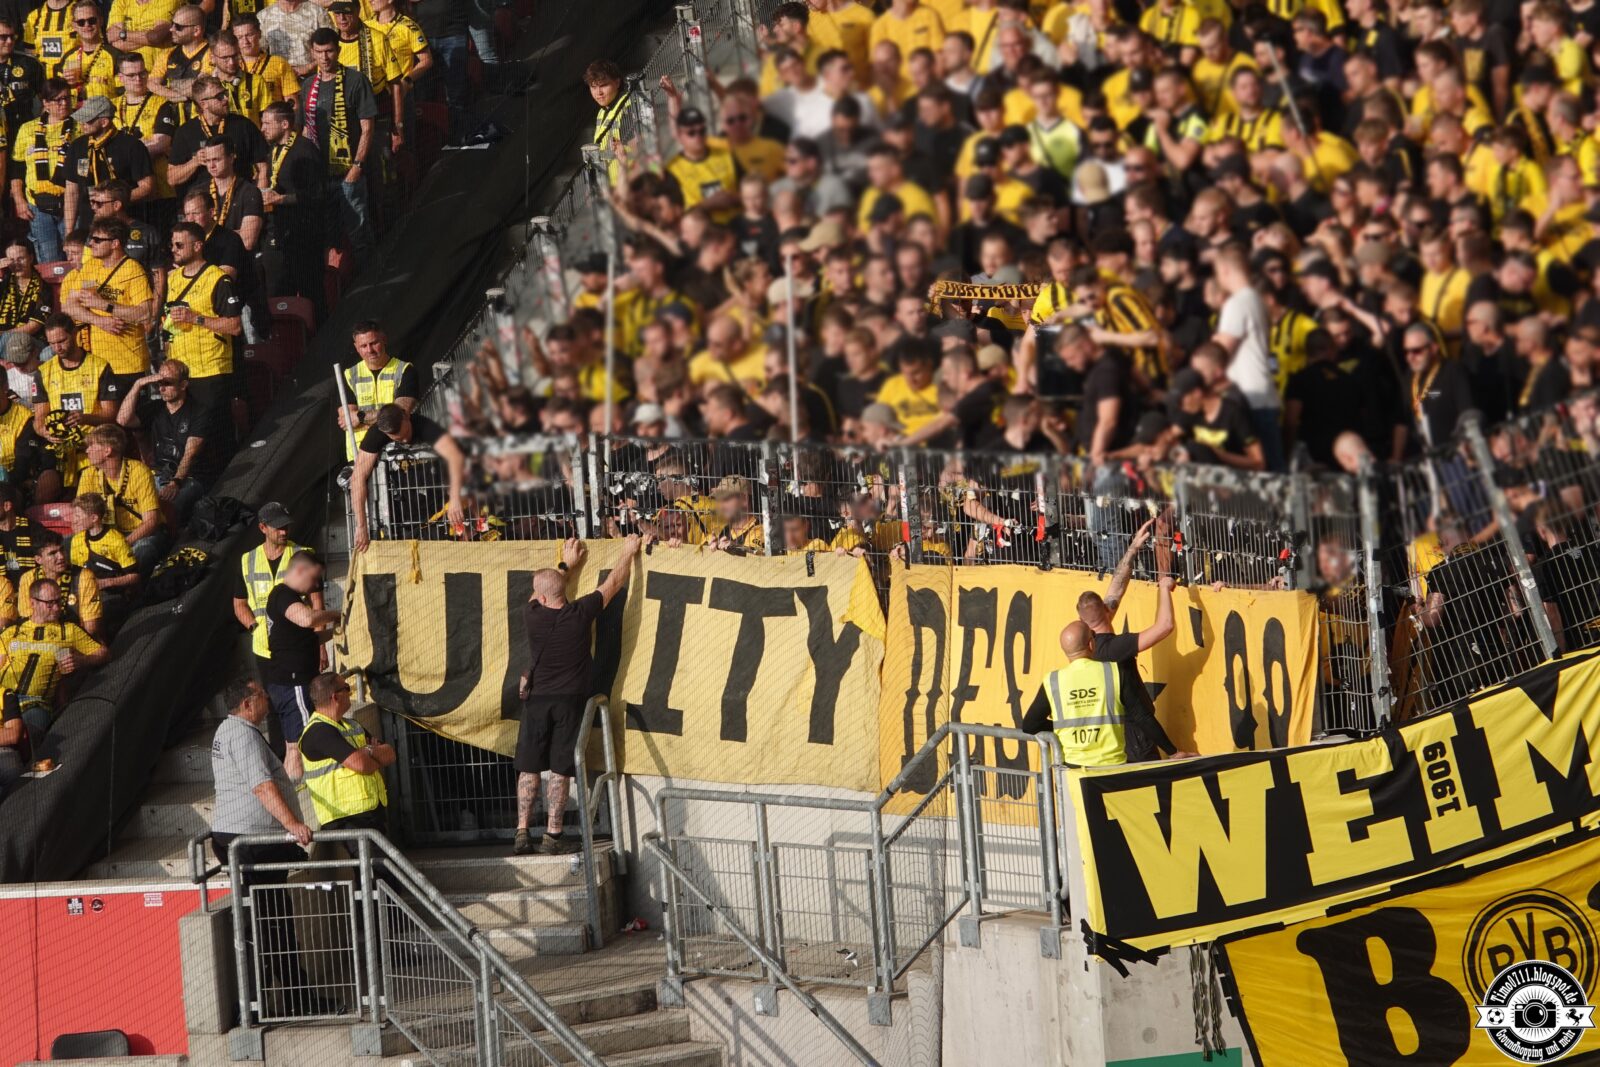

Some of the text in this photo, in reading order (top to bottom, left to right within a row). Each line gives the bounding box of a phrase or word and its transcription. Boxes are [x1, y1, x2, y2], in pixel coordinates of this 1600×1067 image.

[42, 41, 61, 53] 1&1
[61, 397, 82, 411] 1&1
[1069, 687, 1097, 700] SDS
[1071, 727, 1101, 744] 1077
[1422, 740, 1462, 818] 1909
